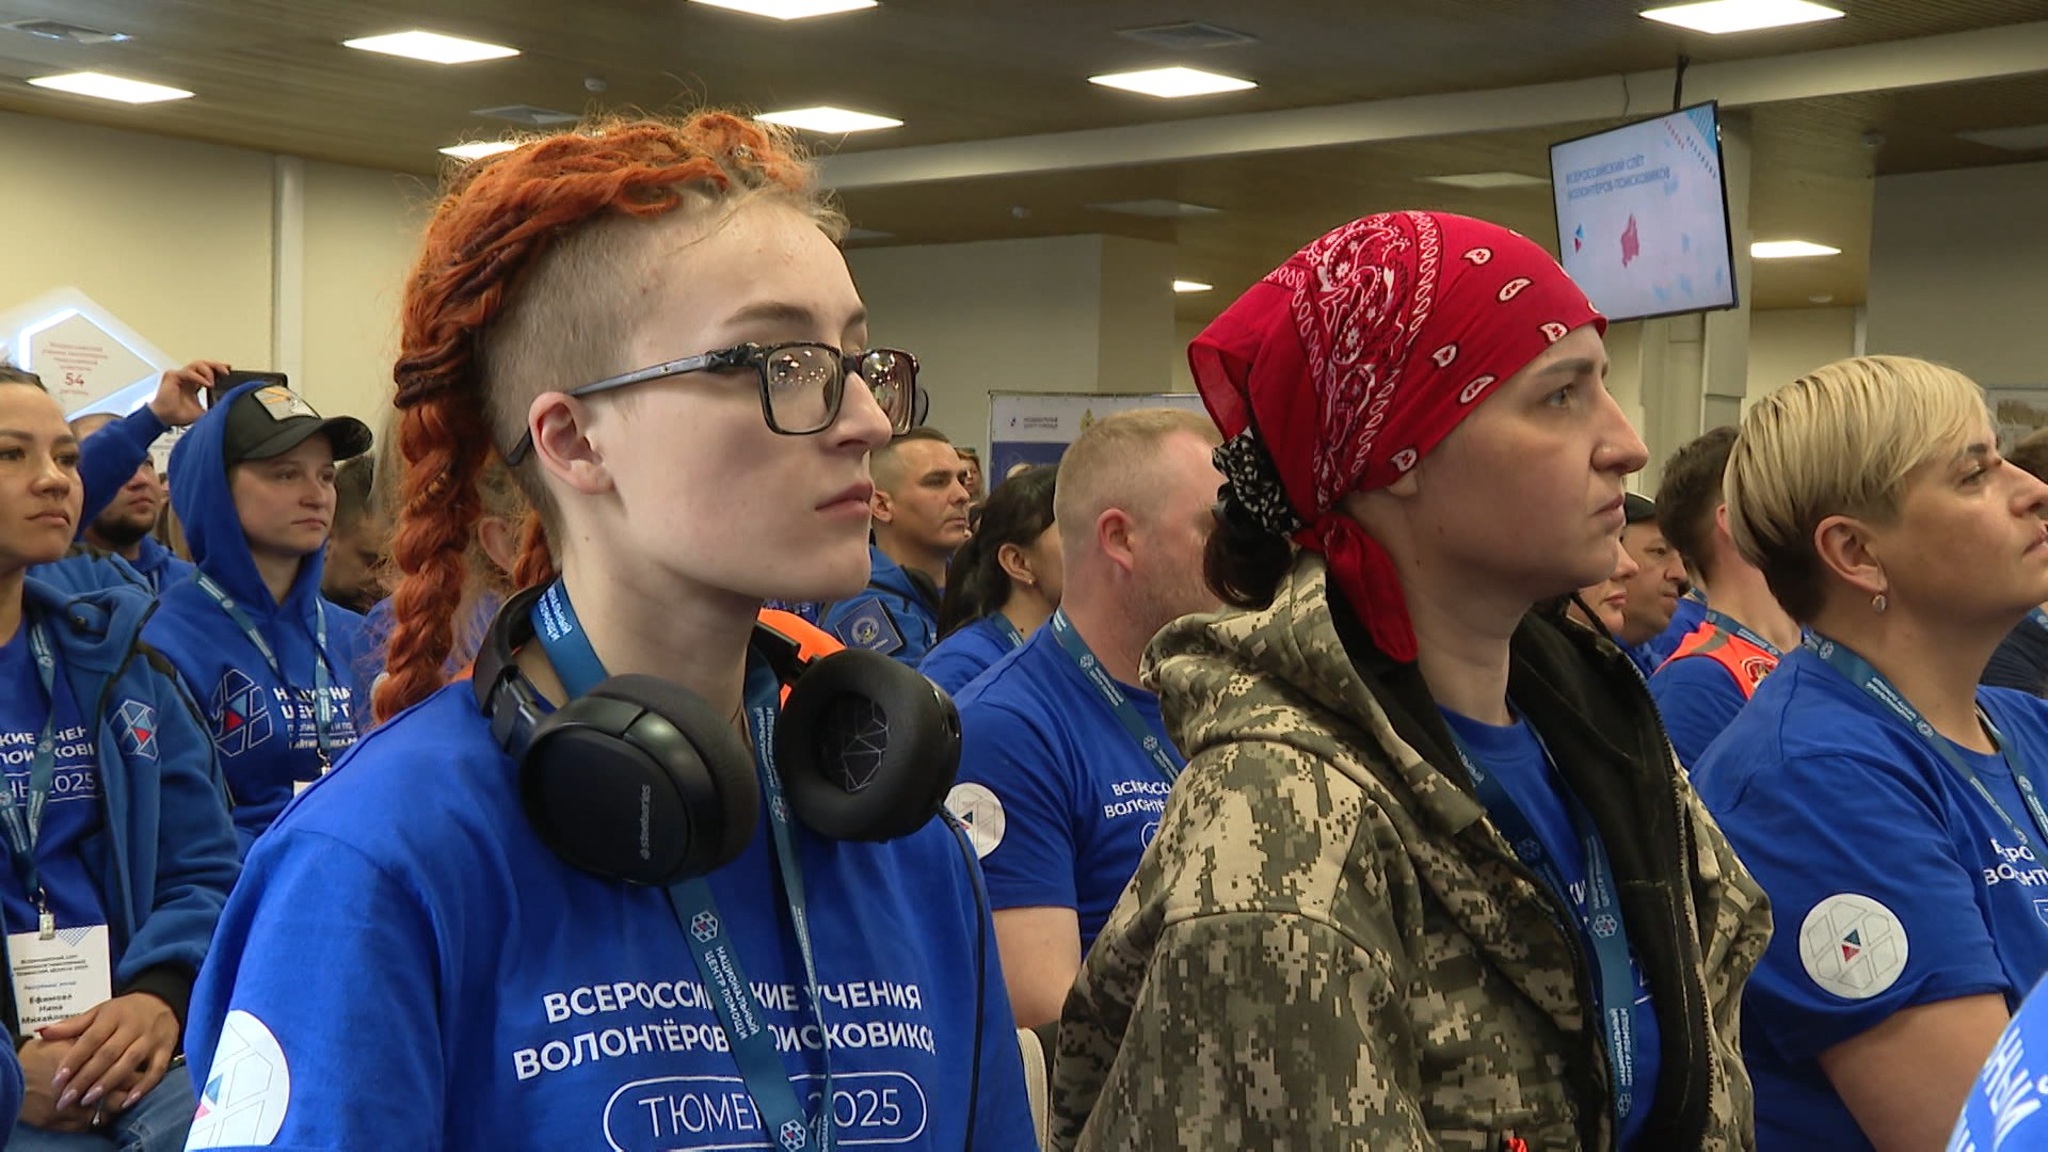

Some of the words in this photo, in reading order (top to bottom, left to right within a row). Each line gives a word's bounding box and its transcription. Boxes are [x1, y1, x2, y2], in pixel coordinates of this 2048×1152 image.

[65, 373, 84, 386] 54
[704, 950, 726, 988] ЦЕНТР
[721, 988, 748, 1041] ПОМОЩИ
[716, 945, 760, 1036] НАЦИОНАЛЬНЫЙ
[513, 1018, 730, 1081] ВОЛОНТЁРОВ
